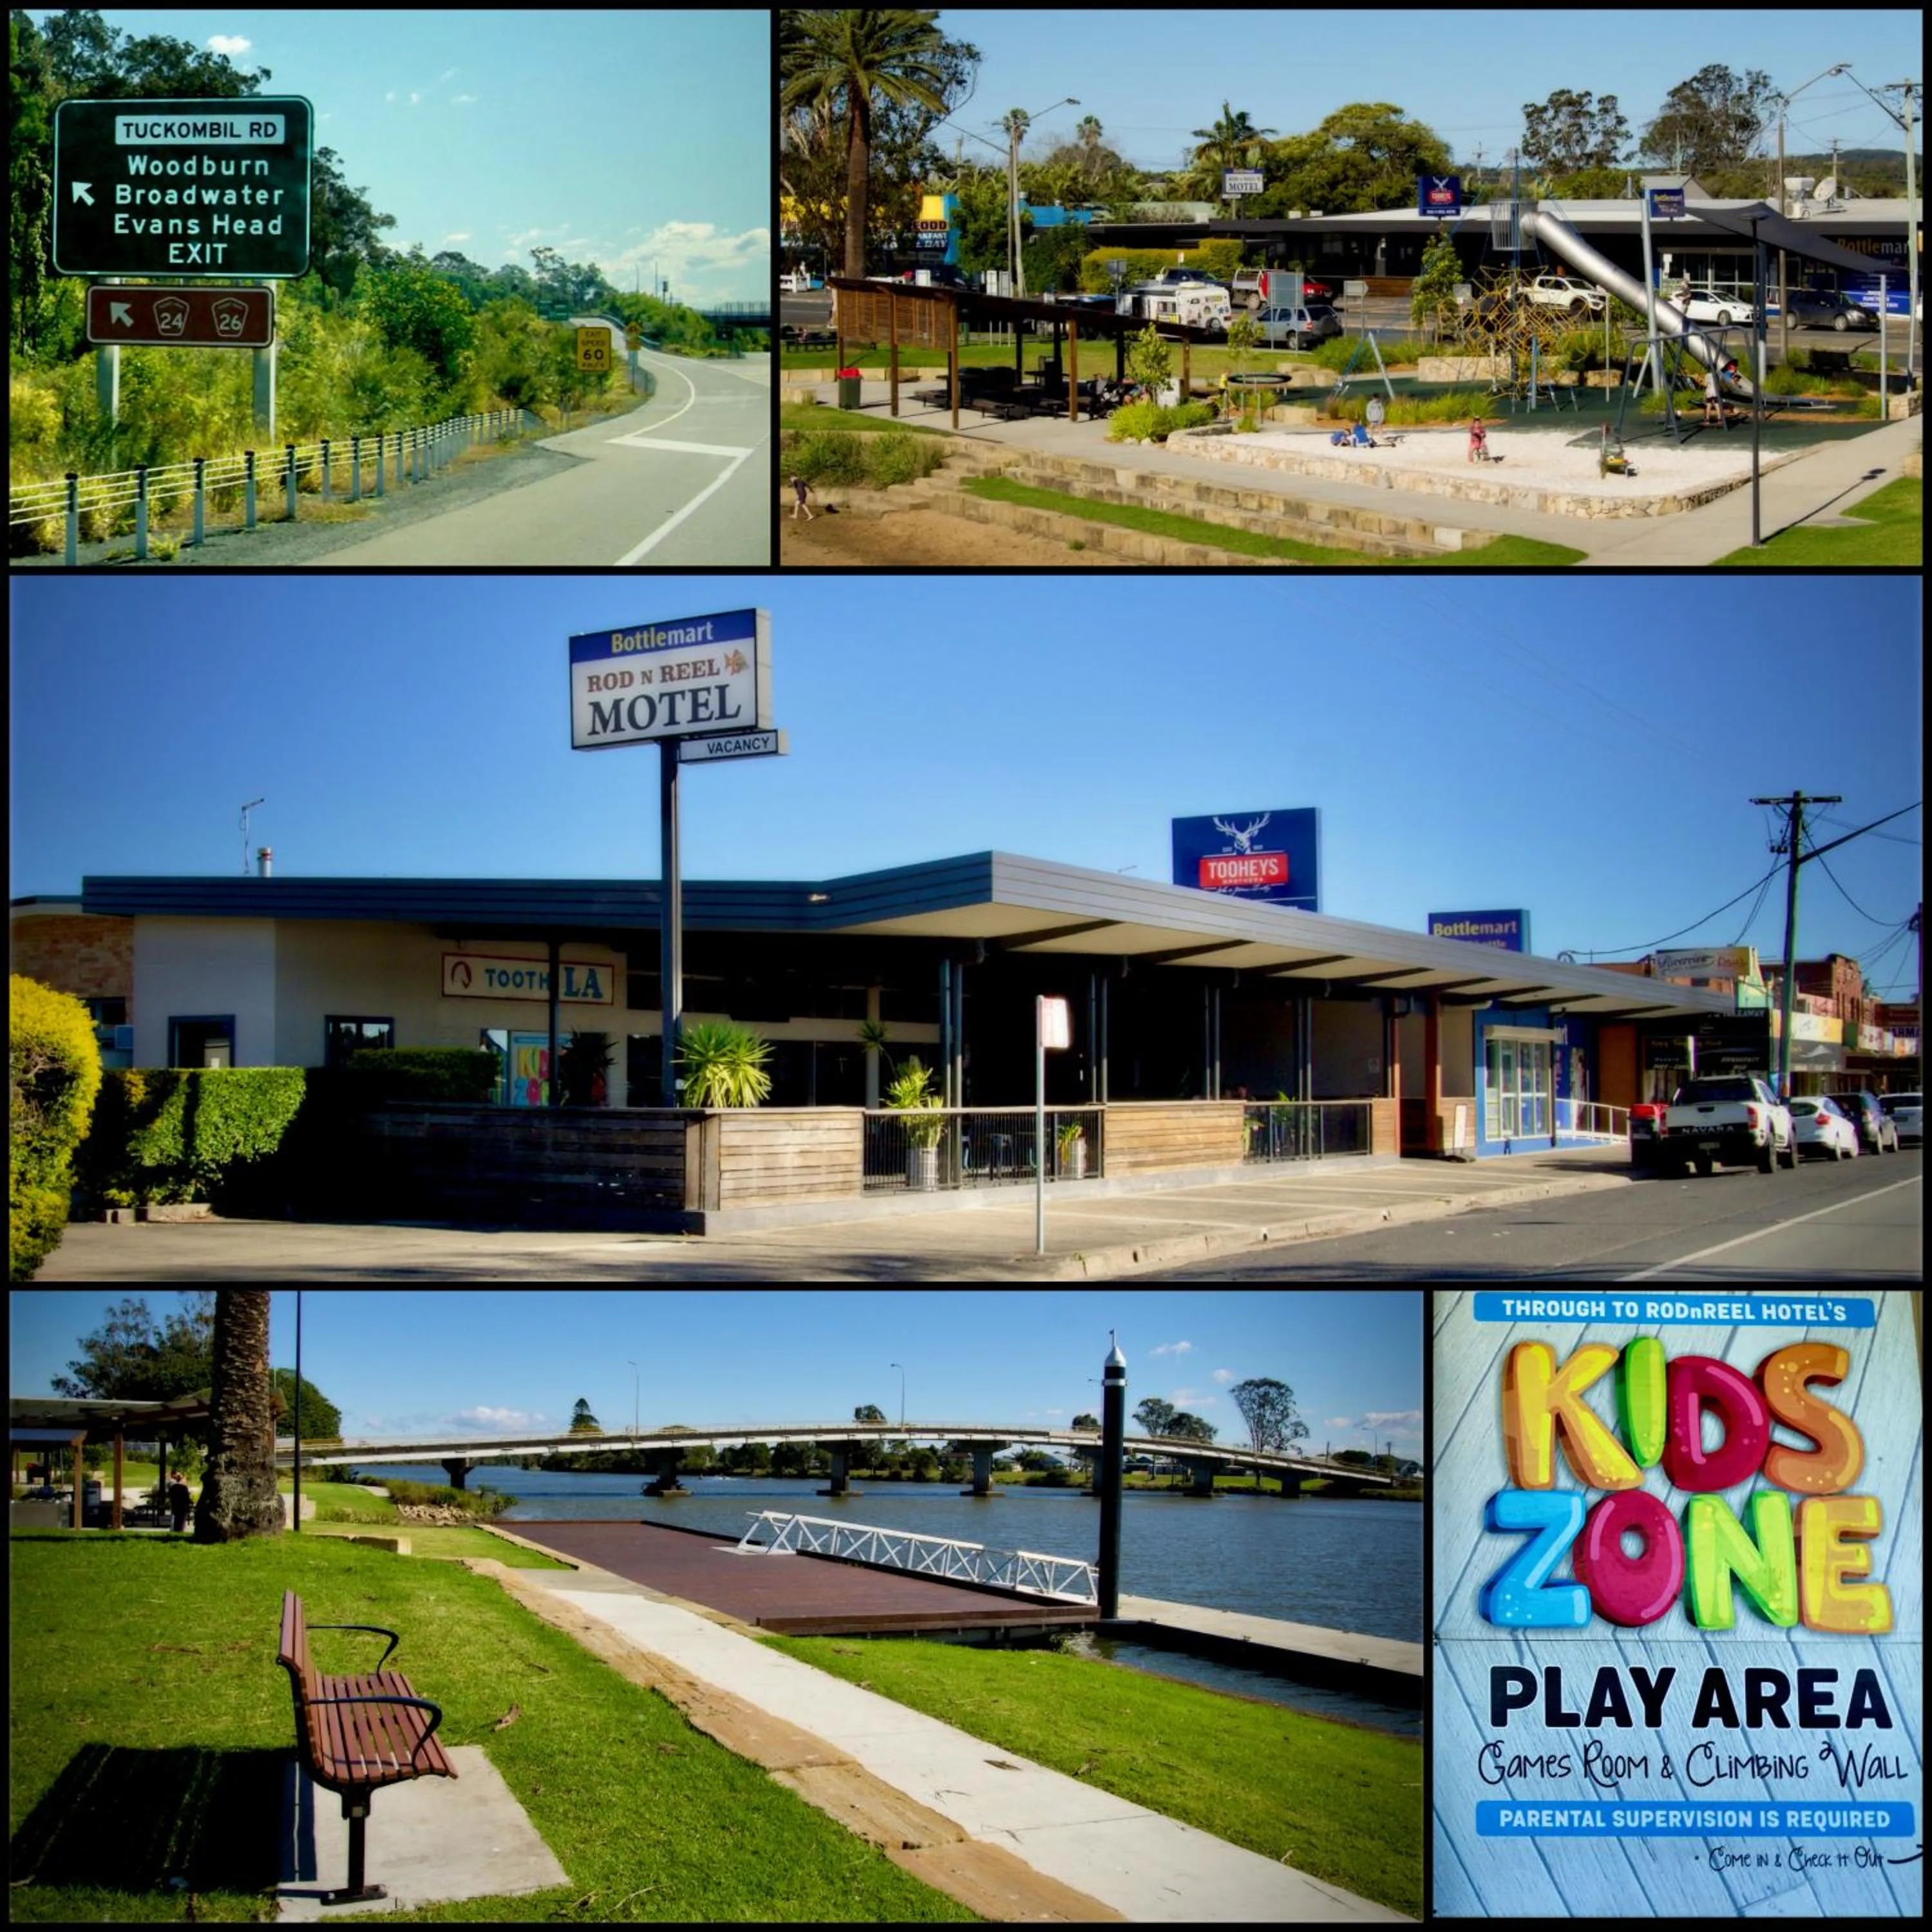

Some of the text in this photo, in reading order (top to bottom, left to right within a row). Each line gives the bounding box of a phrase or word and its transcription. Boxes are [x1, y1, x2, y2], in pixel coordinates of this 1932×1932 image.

[122, 121, 278, 139] TUCKOMBIL RD
[128, 155, 270, 176] Woodburn
[115, 184, 284, 205] Broadwater
[113, 213, 283, 236] Evans Head
[168, 243, 228, 264] EXIT
[1837, 238, 1909, 254] Bottlemar
[160, 313, 182, 330] 24
[219, 314, 242, 331] 26
[583, 349, 604, 360] 60
[612, 621, 714, 654] Bottlemart
[587, 658, 721, 693] ROD N REEL
[587, 683, 742, 736] MOTEL
[706, 737, 770, 754] VACANCY
[1207, 857, 1279, 880] TOOHEYS
[1433, 920, 1517, 936] Bottlemart
[564, 967, 603, 998] LA
[1681, 1125, 1734, 1134] NAVARA
[1502, 1299, 1848, 1321] THROUGH TO RODnREEL HOTEL'S
[1501, 1336, 1864, 1495] KIDS
[1479, 1489, 1895, 1635] ZONE
[1488, 1665, 1894, 1730] PLAY AREA
[1660, 1754, 1674, 1779] &
[1499, 1810, 1891, 1832] PARENTAL SUPERVISION IS REQUIRED
[1774, 1855, 1782, 1868] &
